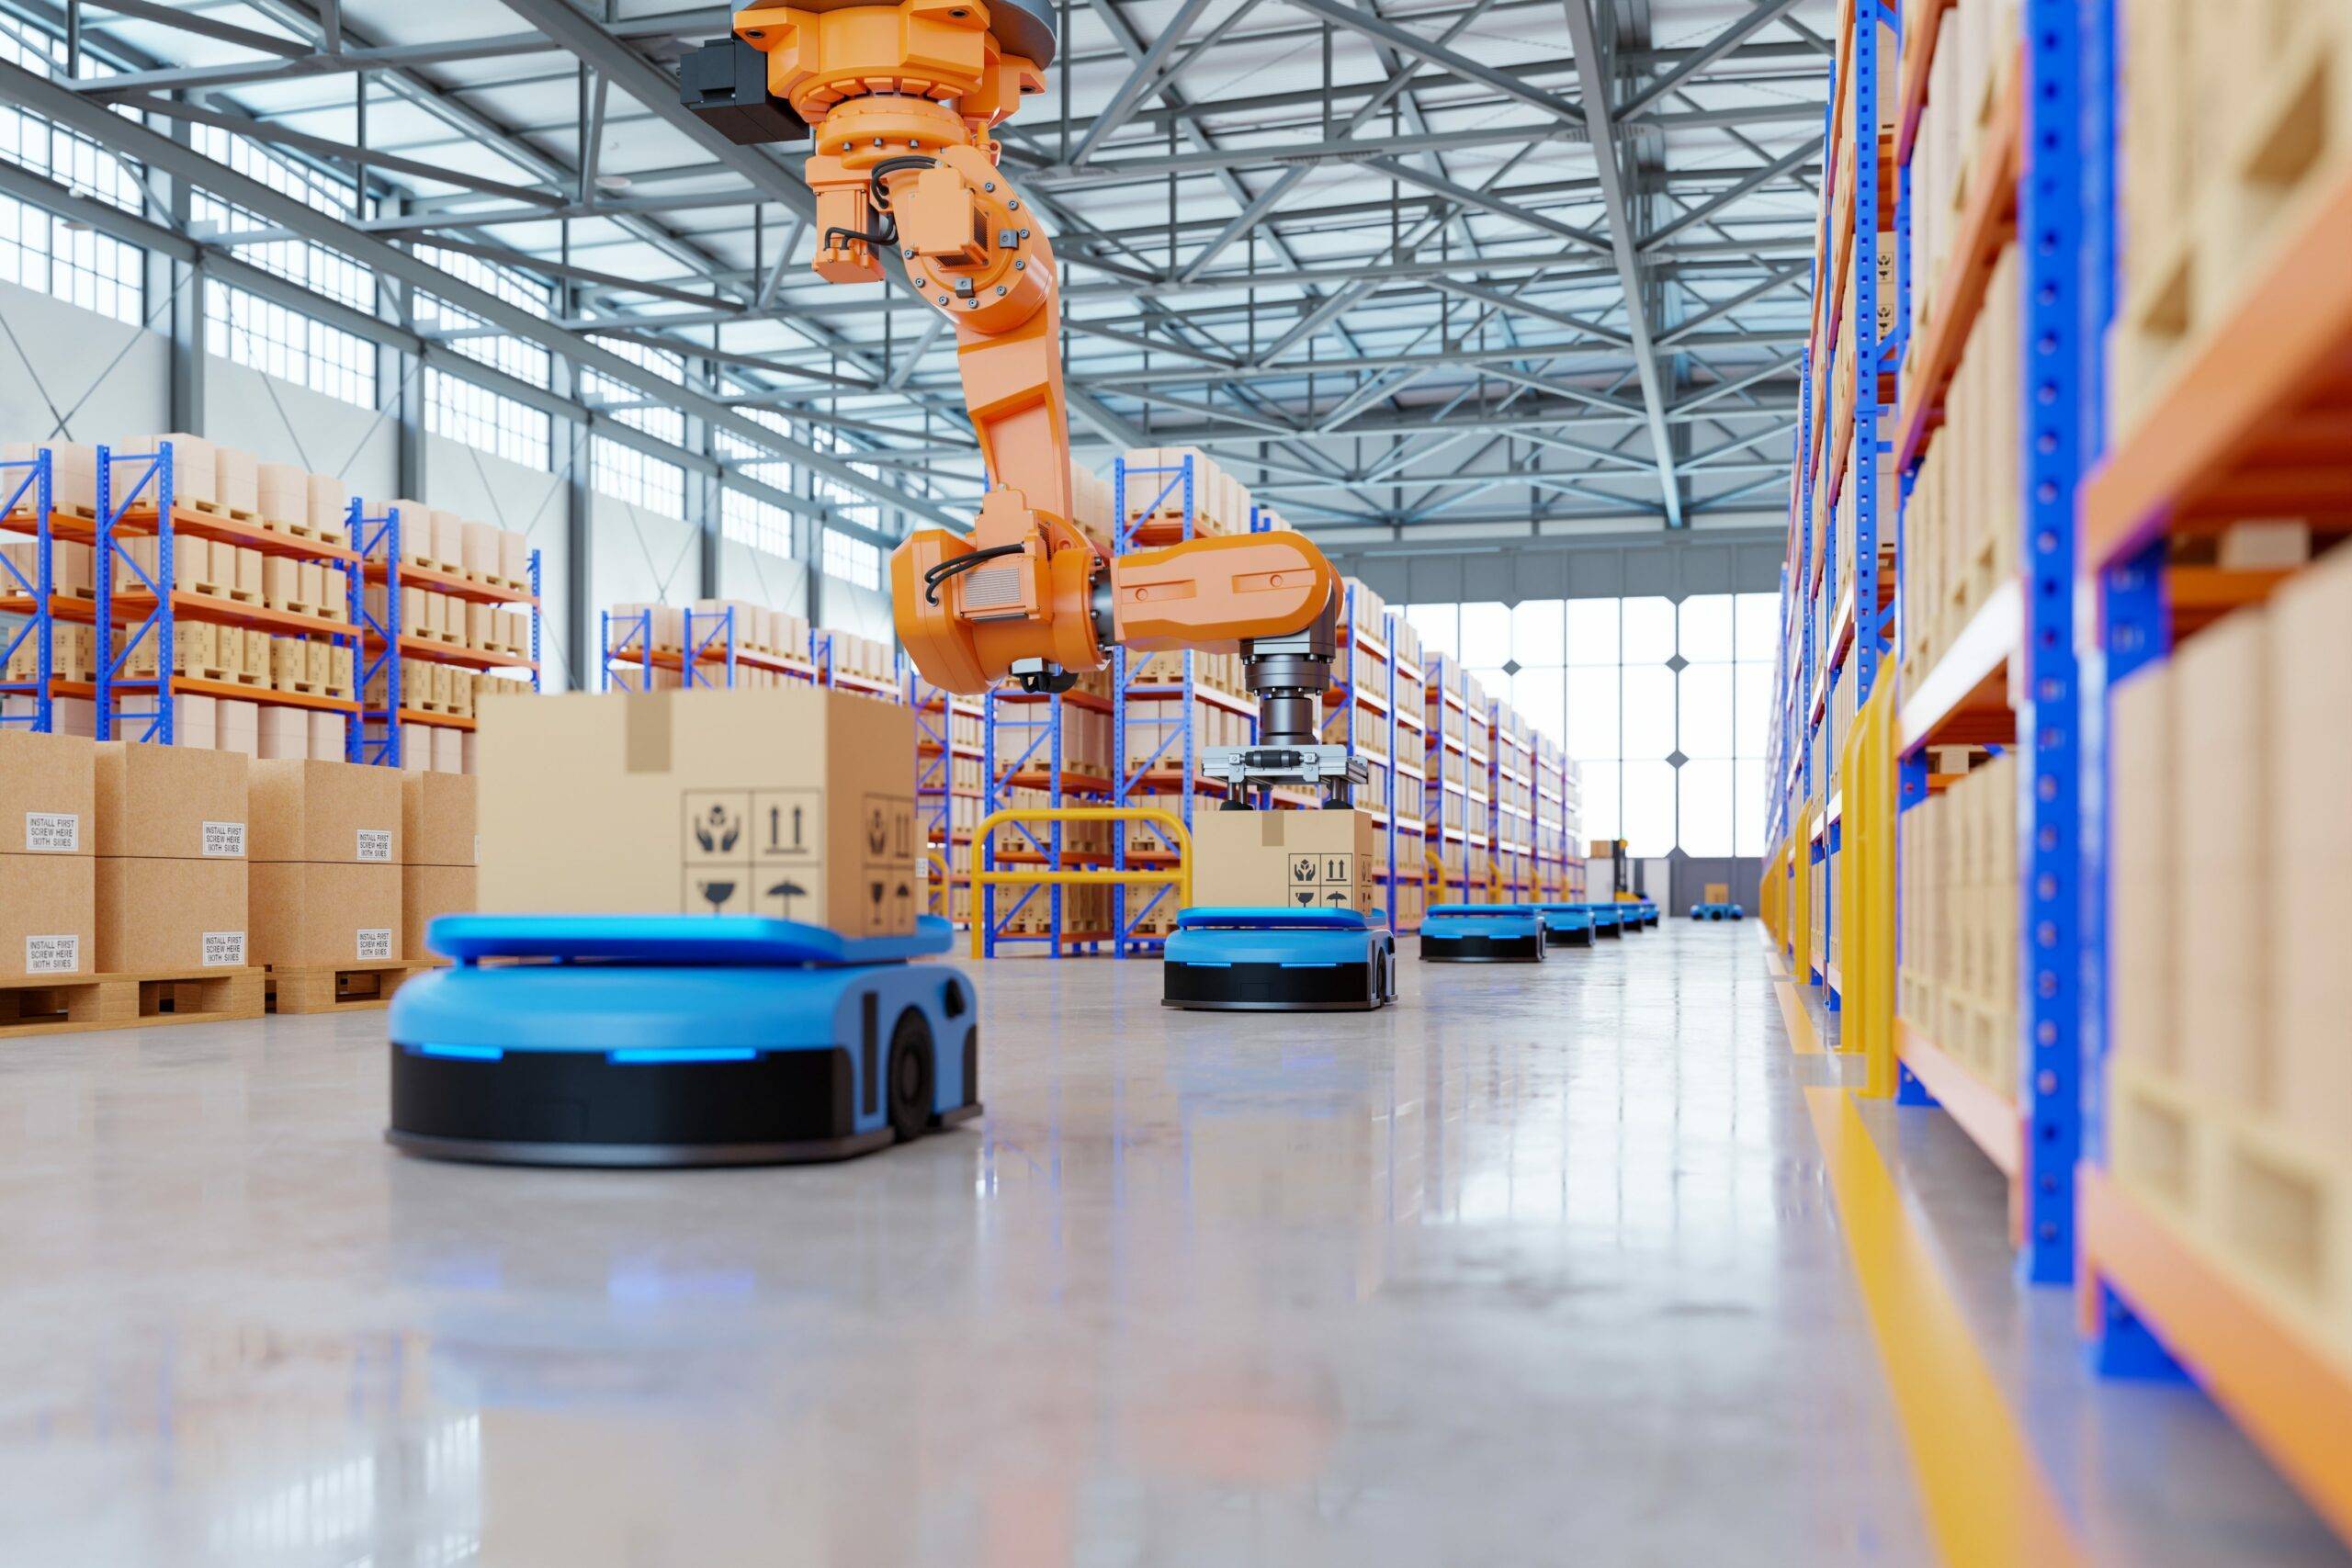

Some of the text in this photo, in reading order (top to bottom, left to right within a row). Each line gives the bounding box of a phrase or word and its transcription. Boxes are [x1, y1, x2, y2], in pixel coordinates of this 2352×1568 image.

[30, 818, 74, 828] INSTALL FIRST
[31, 827, 73, 837] SCREW HERE
[206, 826, 241, 835] INSTALL FIRST
[33, 837, 71, 846] BOTH SIDES
[30, 940, 74, 949] INSTALL FIRST
[31, 950, 73, 959] SCREW HERE
[33, 959, 71, 968] BOTH SIDES
